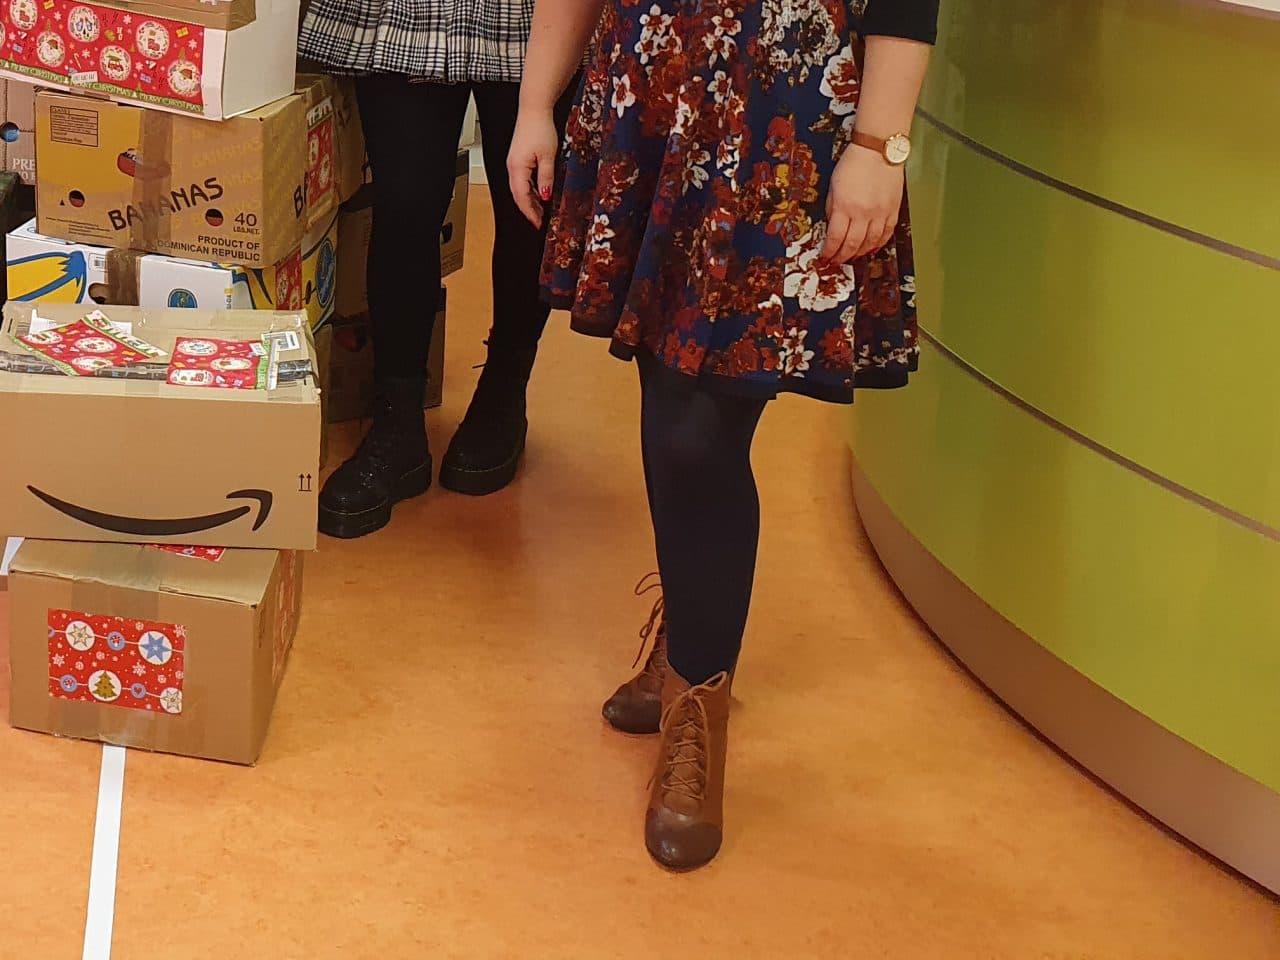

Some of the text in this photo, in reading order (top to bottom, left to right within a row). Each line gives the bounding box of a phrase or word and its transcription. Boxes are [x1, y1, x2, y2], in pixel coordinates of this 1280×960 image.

[12, 158, 36, 171] PRE
[107, 177, 224, 231] BANANAS
[234, 212, 258, 227] 40
[198, 235, 260, 250] PRODUCT OF
[157, 240, 260, 262] DOMINICAN REPUBLIC
